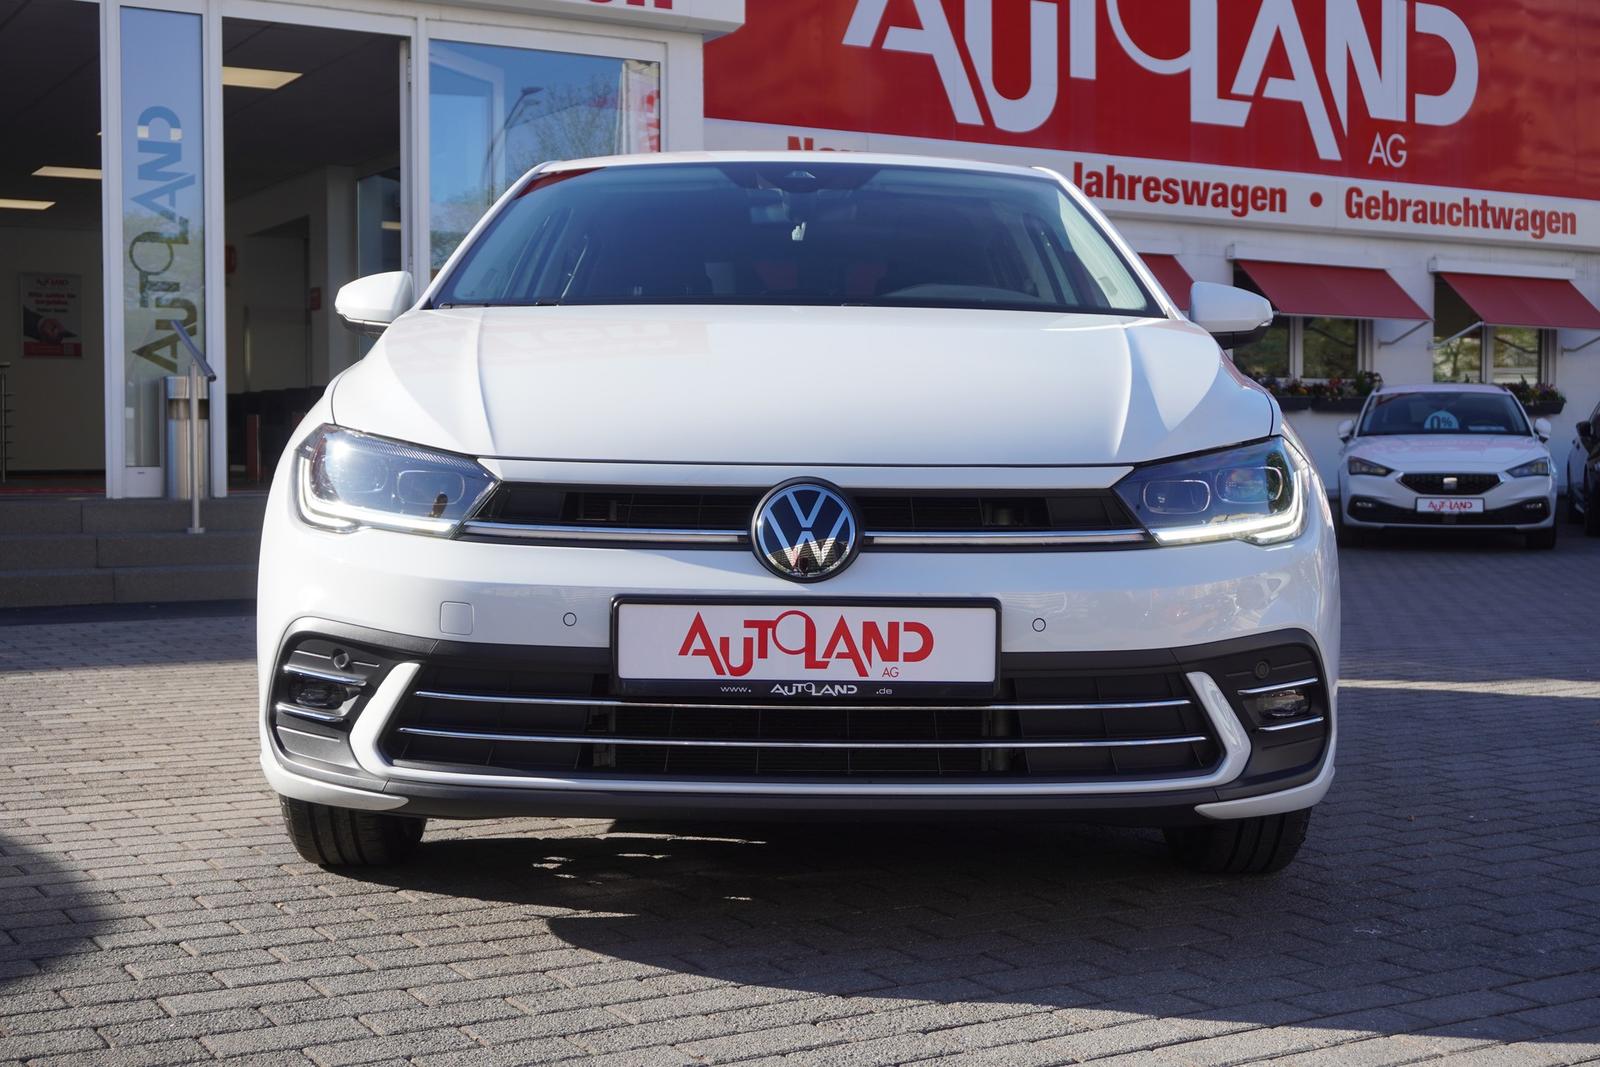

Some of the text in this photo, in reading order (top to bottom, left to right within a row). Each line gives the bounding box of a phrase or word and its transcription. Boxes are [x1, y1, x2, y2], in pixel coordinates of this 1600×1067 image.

[1368, 133, 1407, 168] AG
[1073, 161, 1577, 240] Jahreswagen Gebrauchtwagen
[129, 105, 197, 374] AUTOLAND
[678, 610, 935, 678] AUTOLAND
[720, 682, 893, 697] www. AUTOLAND .de
[881, 666, 900, 679] AG
